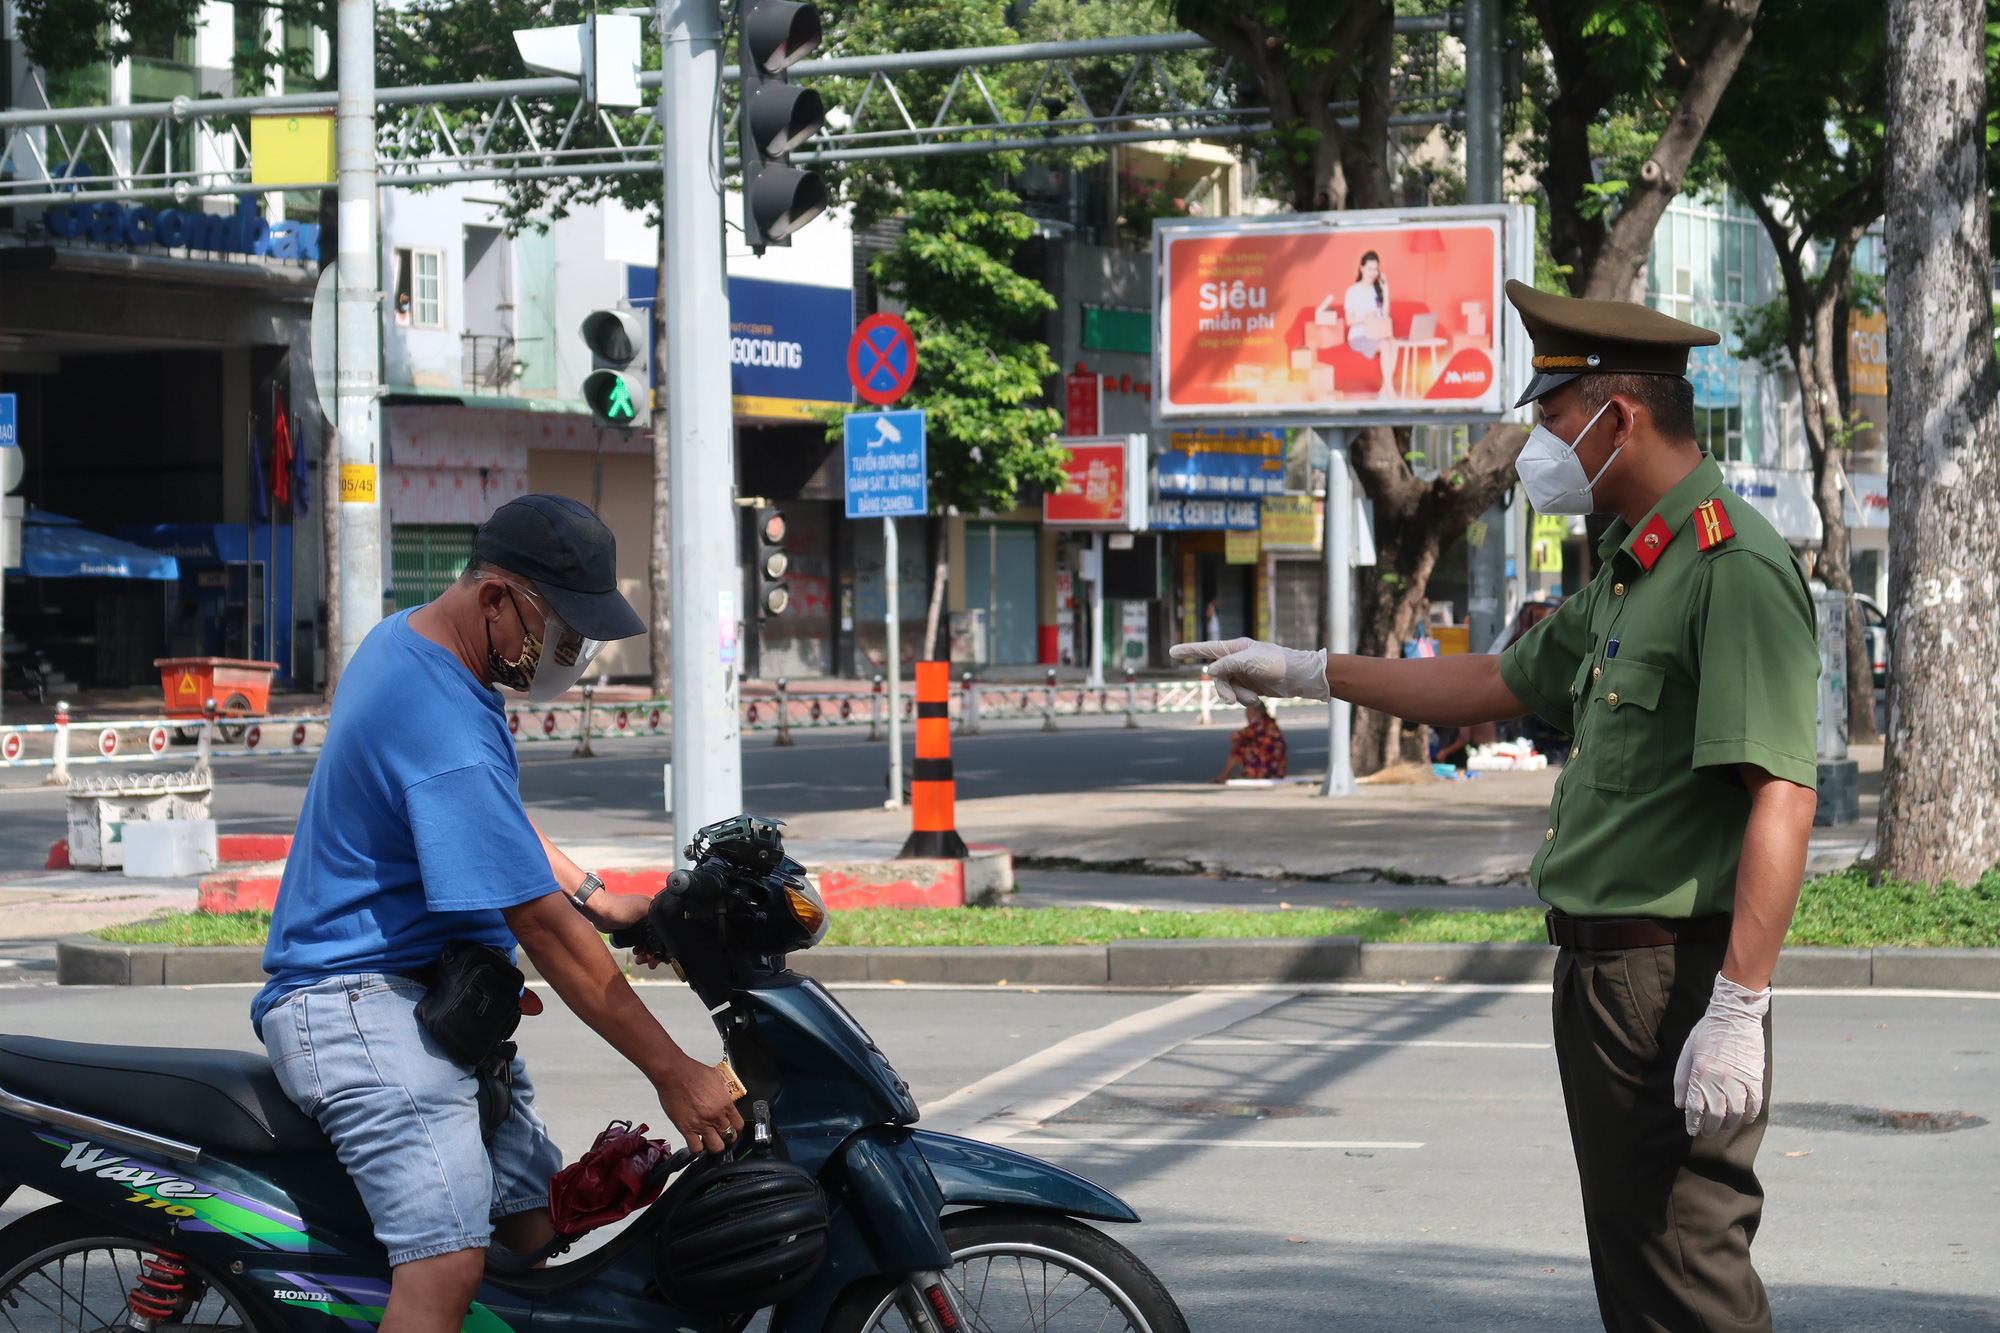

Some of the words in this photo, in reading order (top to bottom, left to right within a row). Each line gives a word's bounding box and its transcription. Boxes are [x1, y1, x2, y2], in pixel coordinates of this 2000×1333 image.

[1199, 280, 1267, 311] Siêu
[1199, 311, 1242, 332] miễn
[1246, 312, 1276, 333] phí
[345, 415, 368, 436] 45
[852, 451, 878, 472] TUYẾN
[907, 449, 920, 469] CÓ
[881, 495, 915, 511] CAMERA
[1183, 501, 1226, 526] CENTER
[1227, 502, 1258, 526] CARE
[1923, 577, 1963, 607] 34
[60, 1140, 214, 1199] Wave
[125, 1192, 196, 1217] 110
[273, 1289, 334, 1302] HONDA
